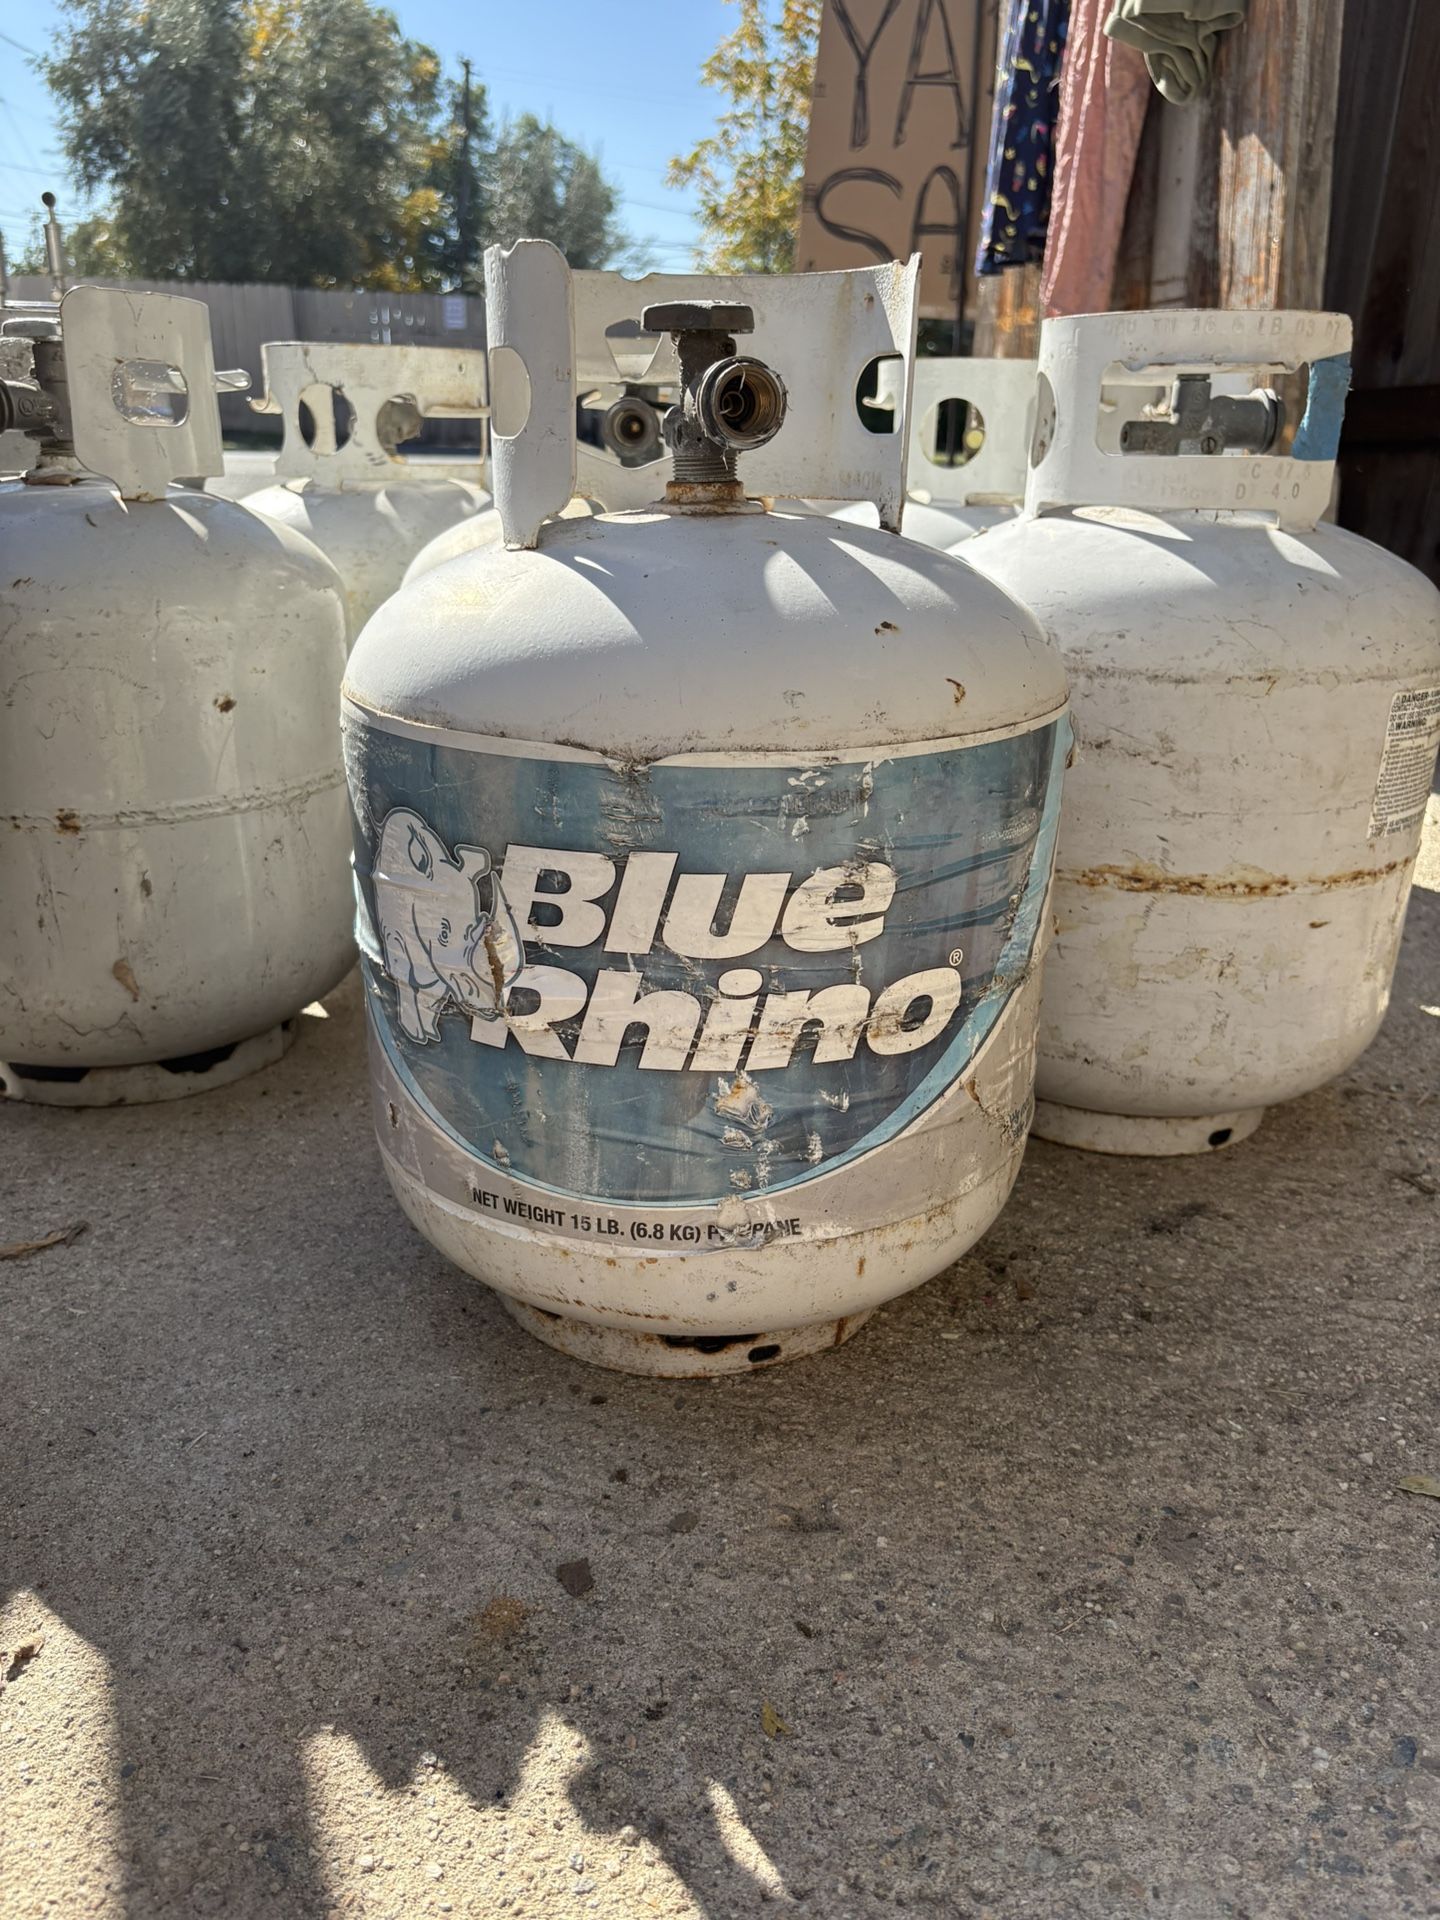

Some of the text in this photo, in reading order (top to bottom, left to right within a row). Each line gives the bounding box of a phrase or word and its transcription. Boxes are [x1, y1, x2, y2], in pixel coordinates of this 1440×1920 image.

[505, 843, 898, 960] Blue
[469, 964, 963, 1073] Rhino
[472, 1187, 802, 1244] NET WEIGHT 15 LB. (6.8 KG) PPANE
